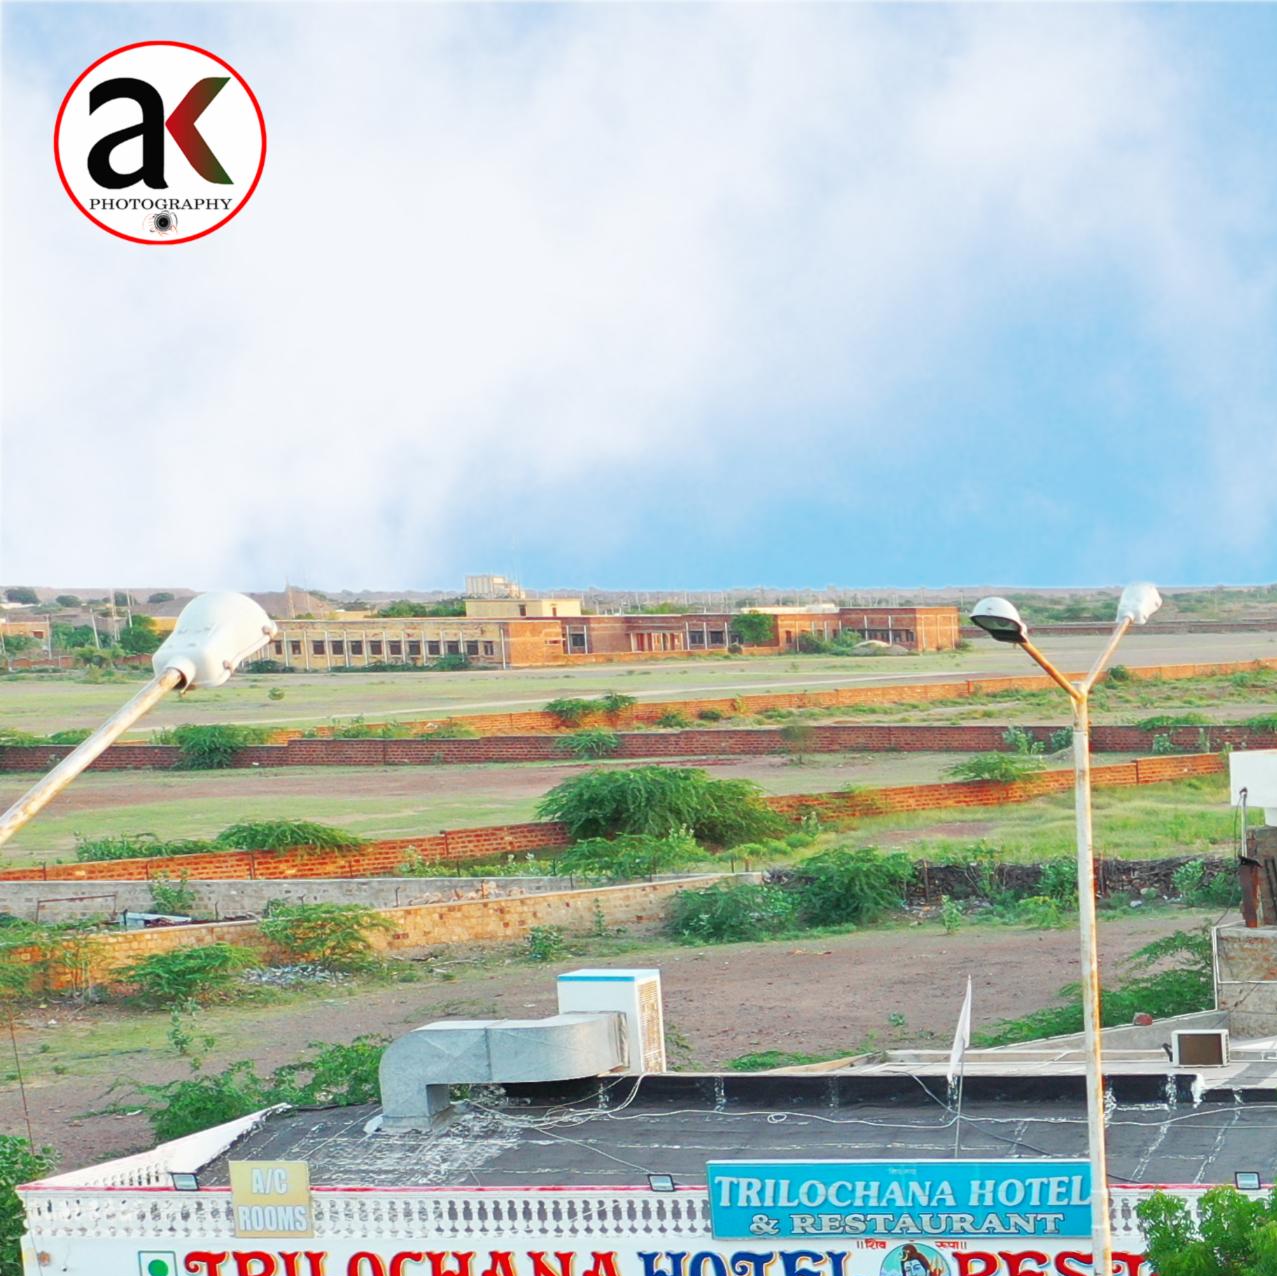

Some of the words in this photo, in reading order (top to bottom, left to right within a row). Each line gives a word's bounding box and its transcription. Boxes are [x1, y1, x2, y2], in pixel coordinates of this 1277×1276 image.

[251, 1167, 288, 1194] A/C
[714, 1176, 957, 1207] TRILOCHANA
[968, 1175, 1092, 1207] HOTEL
[237, 1206, 308, 1232] ROOMS
[749, 1214, 780, 1235] &
[789, 1213, 1065, 1235] RESTAURANT
